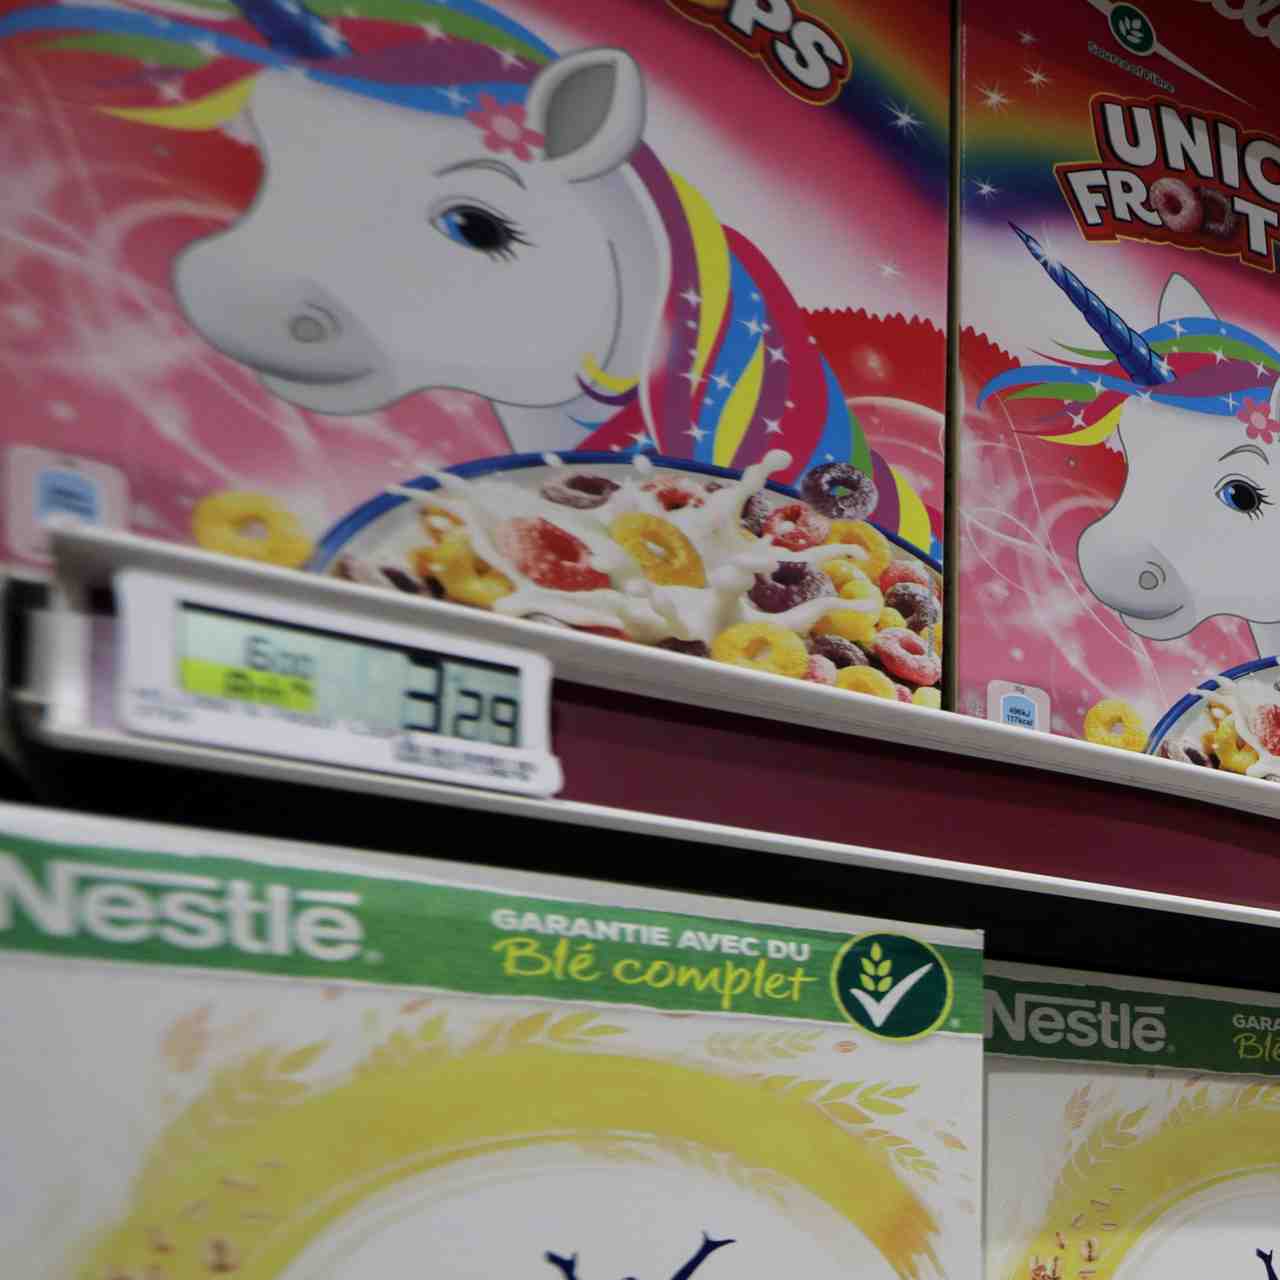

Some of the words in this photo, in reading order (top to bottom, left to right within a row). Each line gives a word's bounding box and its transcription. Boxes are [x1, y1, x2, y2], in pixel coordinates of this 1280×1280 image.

[1067, 169, 1278, 256] FROOT
[0, 849, 366, 961] Nestlé
[491, 906, 672, 950] GARANTIE
[676, 924, 760, 957] AVEC
[768, 938, 811, 962] DU
[492, 931, 603, 983] Blé
[612, 938, 817, 1016] complet
[985, 987, 1168, 1052] Nestlé
